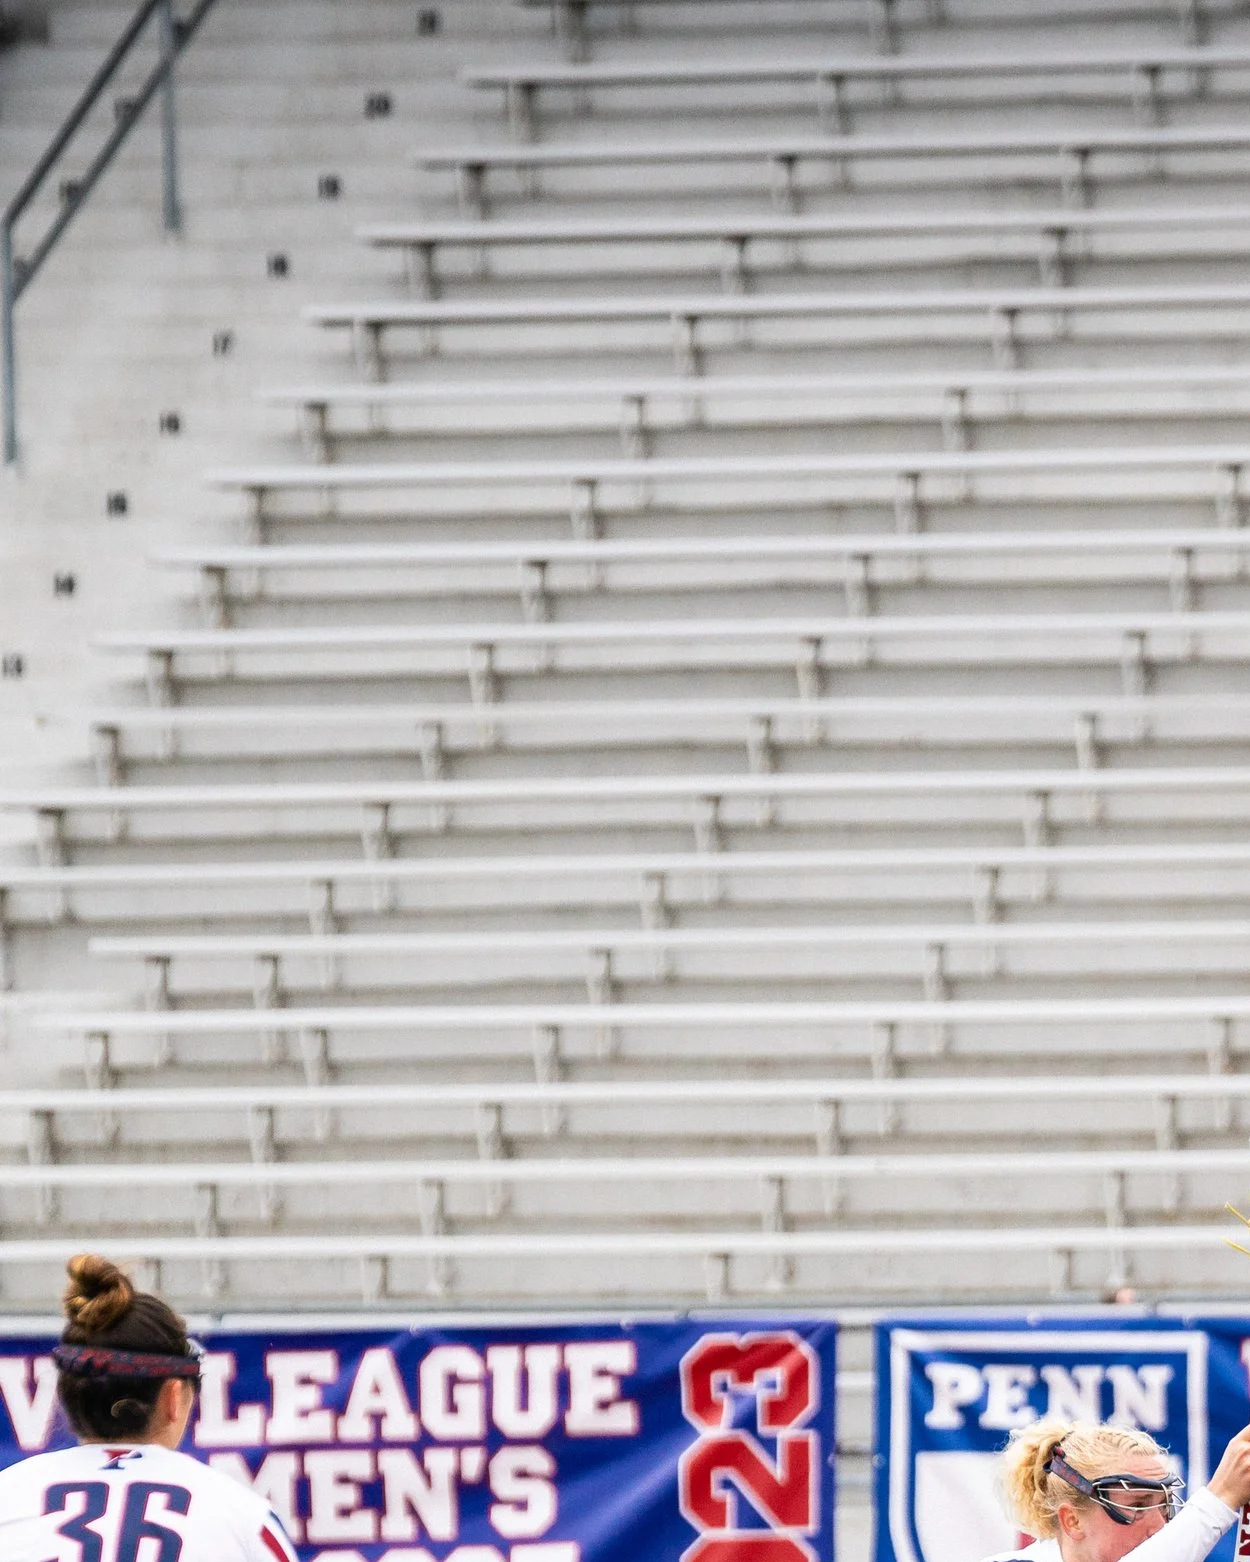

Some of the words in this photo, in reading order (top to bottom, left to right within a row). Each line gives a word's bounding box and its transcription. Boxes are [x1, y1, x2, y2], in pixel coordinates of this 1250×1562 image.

[195, 1343, 638, 1446] LEAGUE
[924, 1363, 1176, 1430] PENN
[208, 1444, 558, 1544] MEN'S
